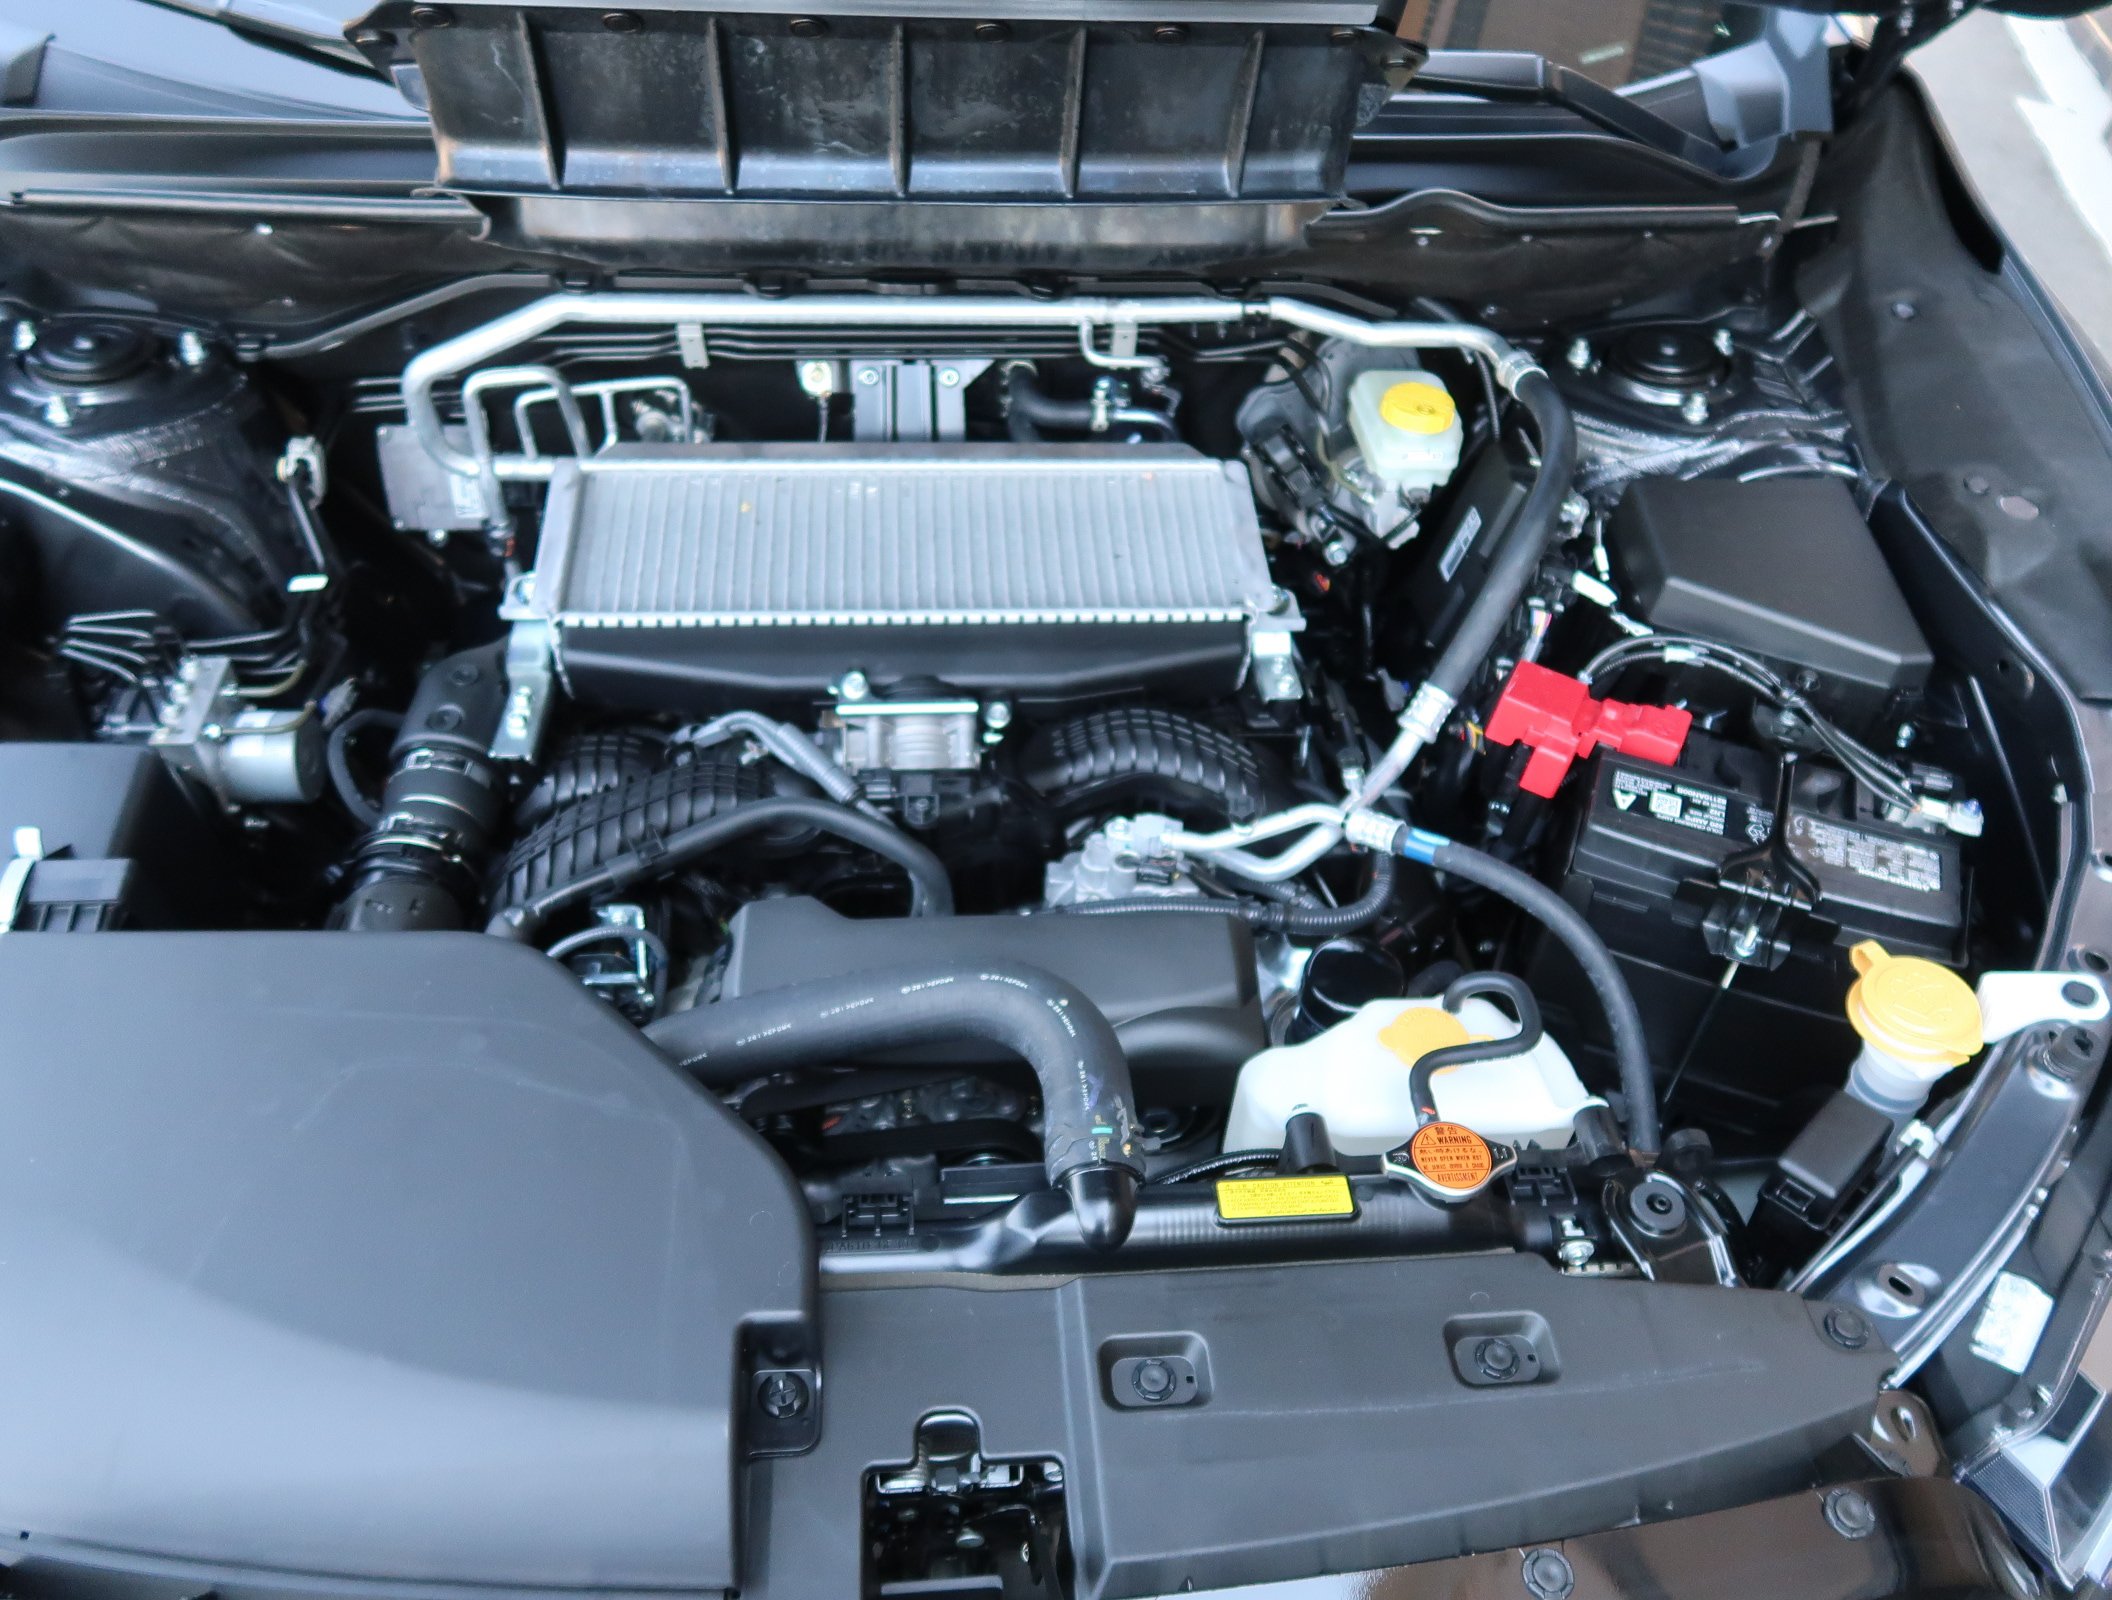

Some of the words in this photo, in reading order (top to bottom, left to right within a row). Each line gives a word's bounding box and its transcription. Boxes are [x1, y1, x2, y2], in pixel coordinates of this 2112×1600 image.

[1683, 814, 1709, 826] AMPS
[1435, 1127, 1458, 1135] 警告
[1437, 1135, 1472, 1144] WARNING
